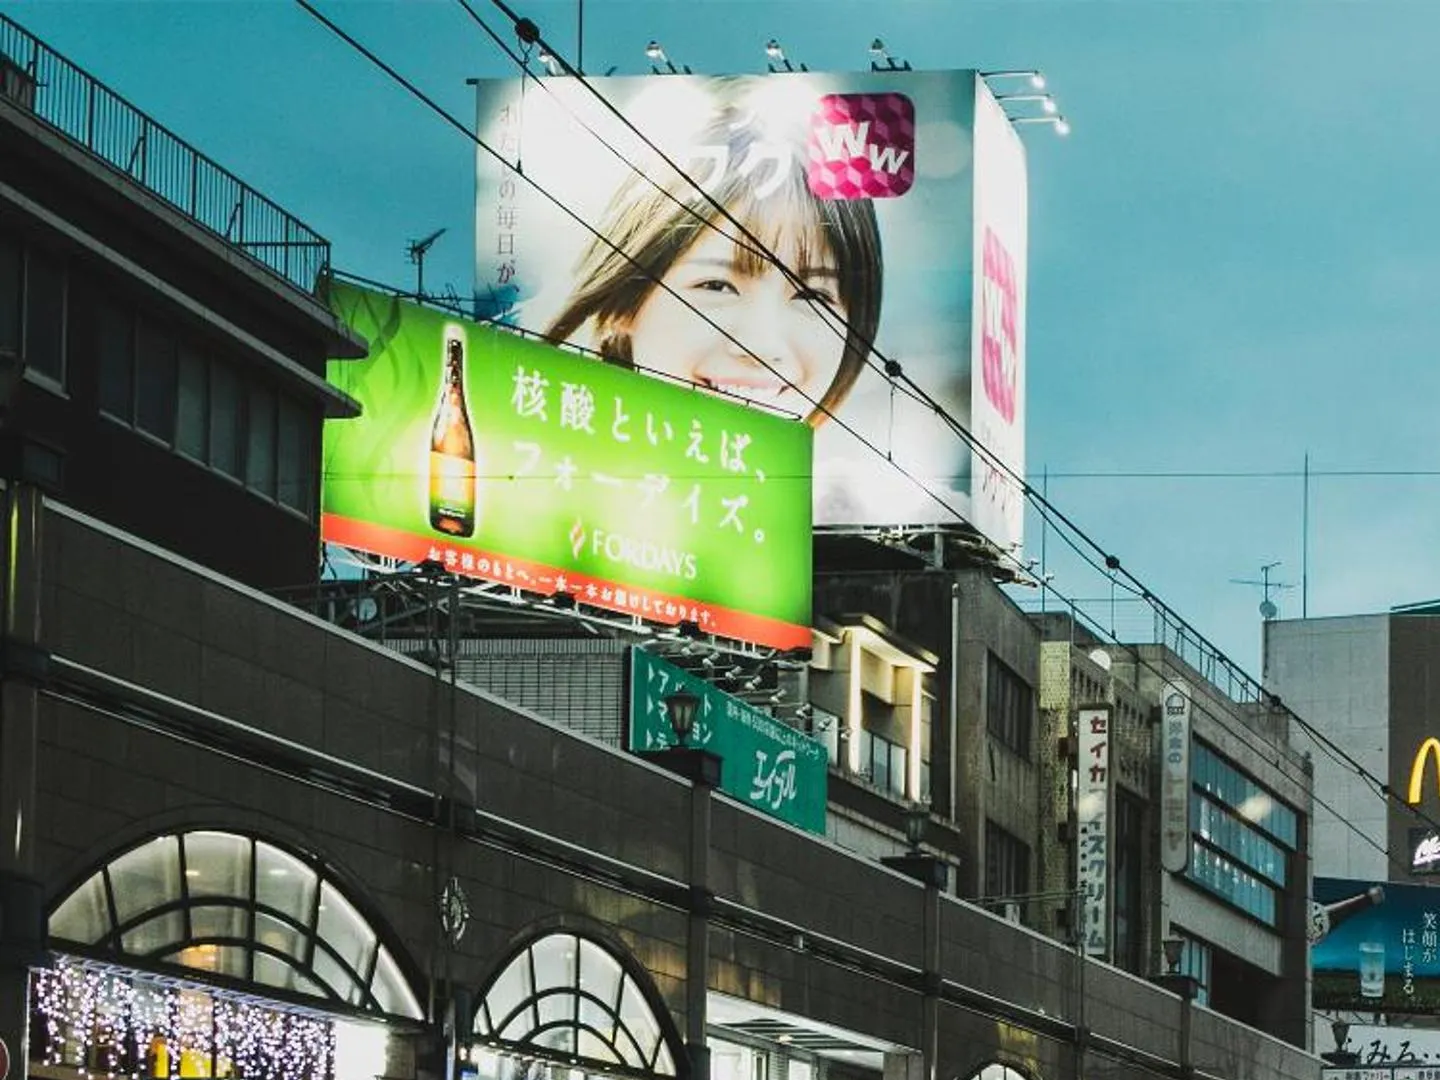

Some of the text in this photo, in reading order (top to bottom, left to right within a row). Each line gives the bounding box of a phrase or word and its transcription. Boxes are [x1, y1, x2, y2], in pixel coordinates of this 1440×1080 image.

[512, 366, 765, 483] 核酸といえば、
[512, 440, 766, 545] フォーデイズ。
[592, 531, 697, 580] FORDAYS
